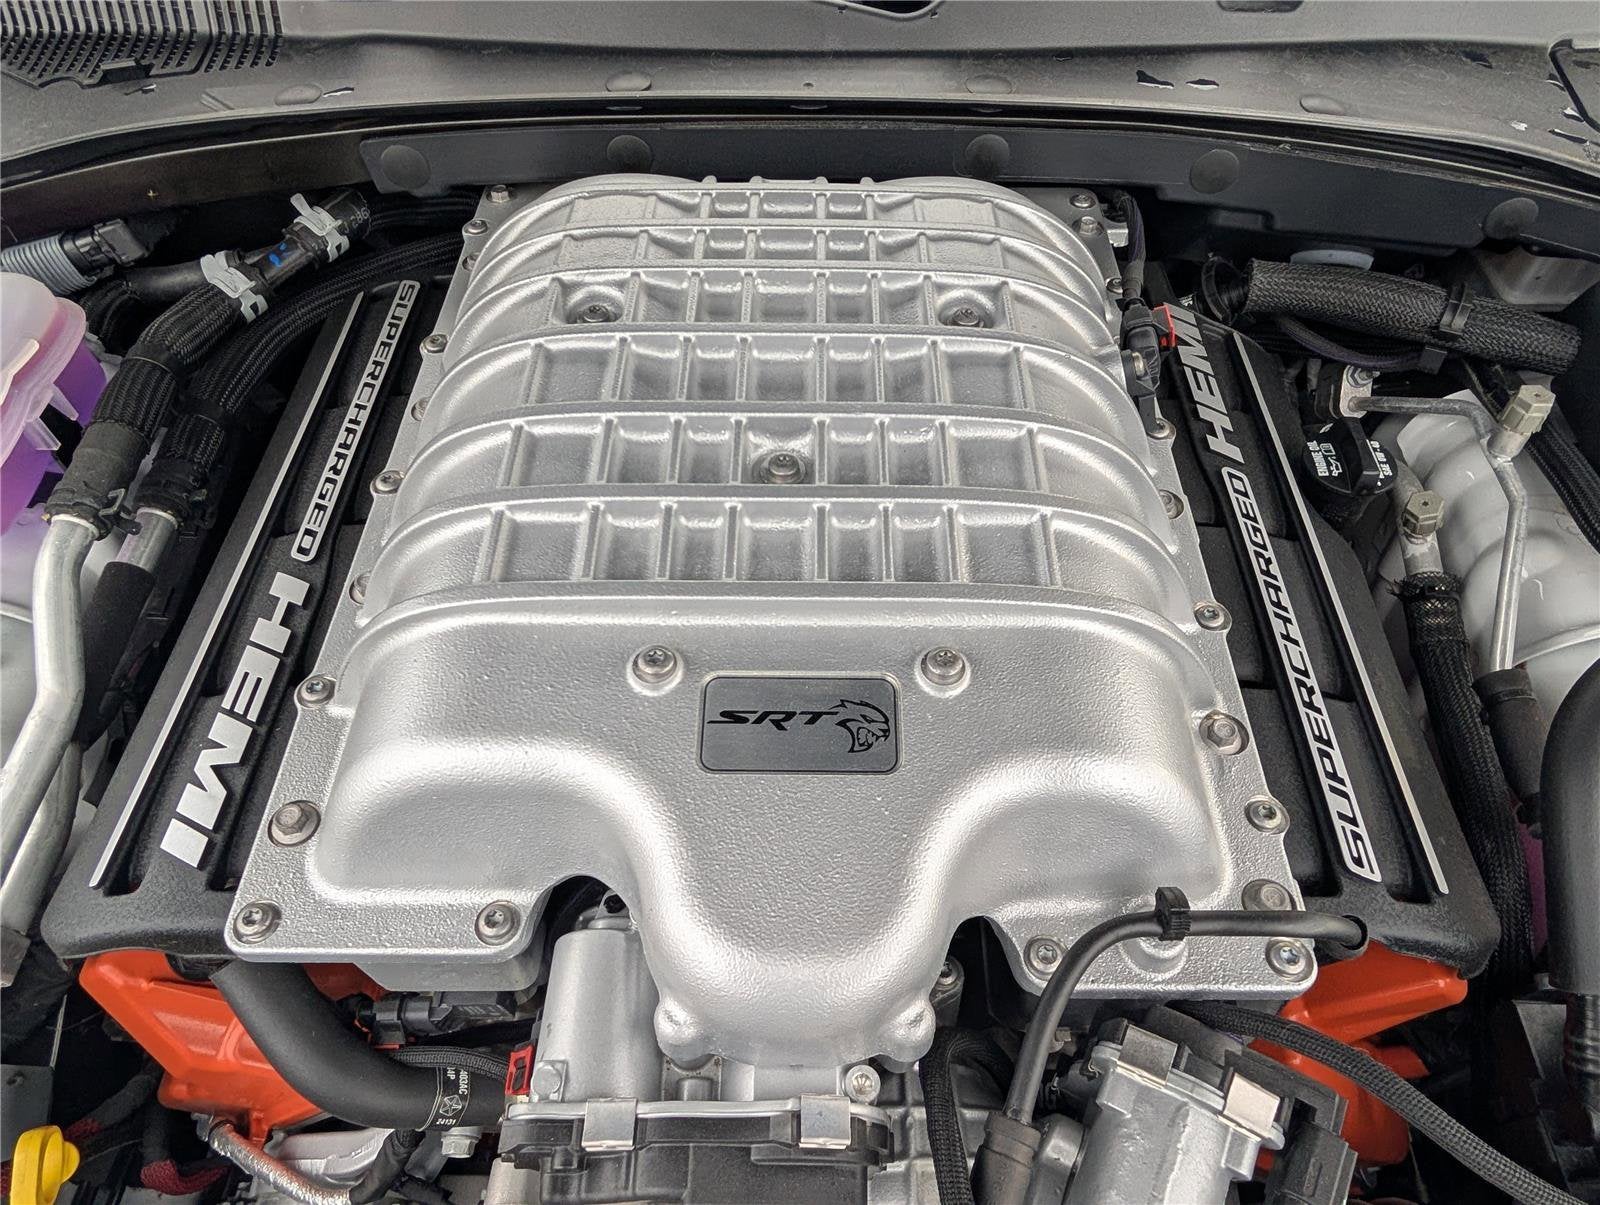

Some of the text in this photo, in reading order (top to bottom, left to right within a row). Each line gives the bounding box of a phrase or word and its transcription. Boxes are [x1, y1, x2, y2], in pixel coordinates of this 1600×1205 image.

[160, 283, 417, 868] SUPERCHARGED HEMI
[1164, 302, 1376, 877] SUPERCHARGED HEMI
[1306, 440, 1329, 476] ENGINE OIL
[707, 710, 839, 731] SRT
